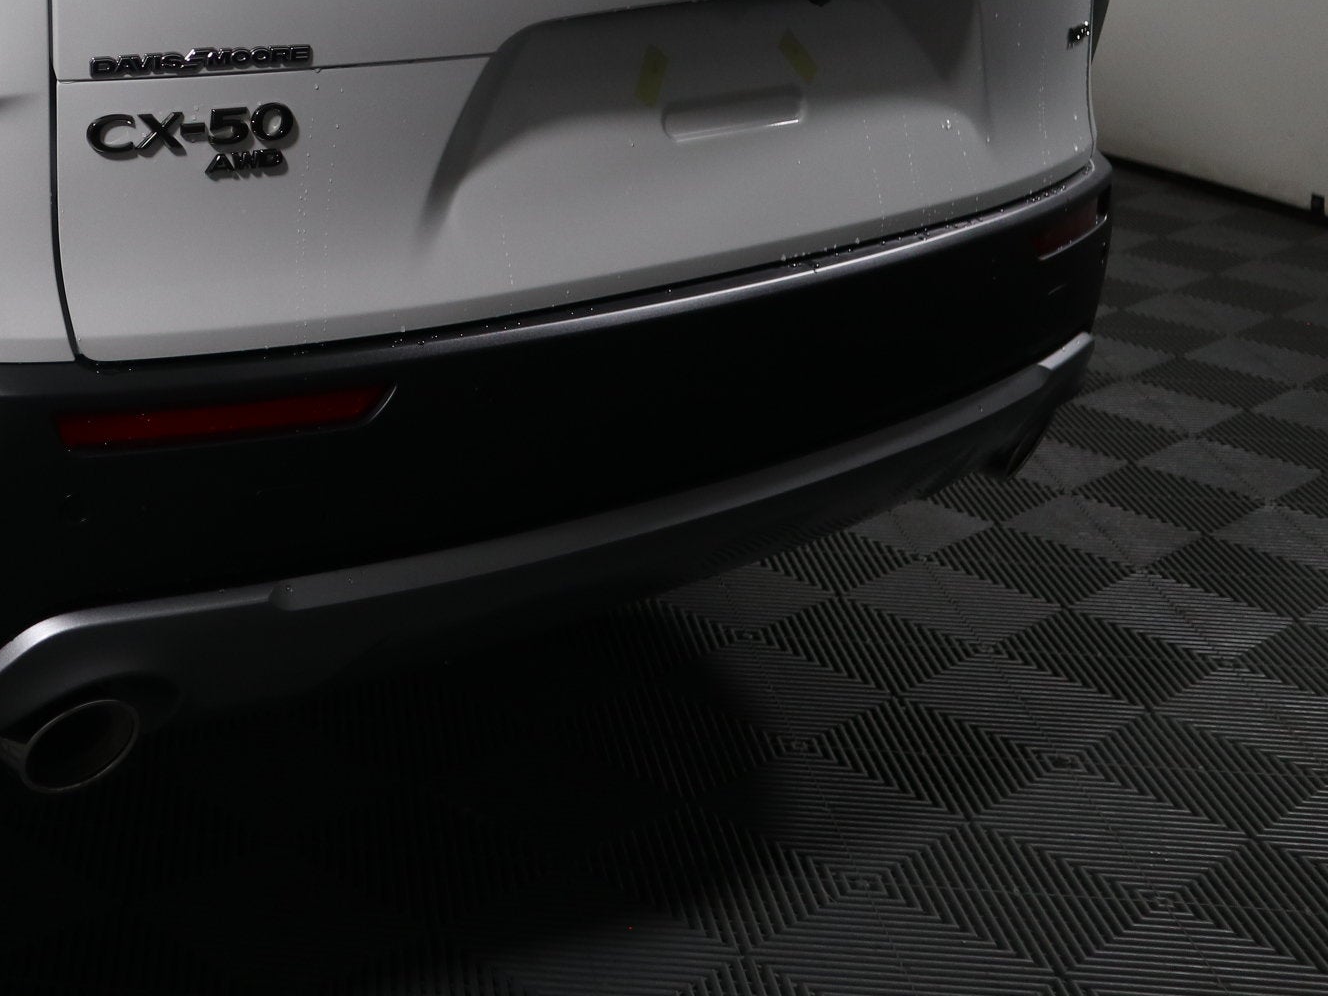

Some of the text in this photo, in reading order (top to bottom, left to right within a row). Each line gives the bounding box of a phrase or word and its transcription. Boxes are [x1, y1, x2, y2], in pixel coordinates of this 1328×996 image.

[89, 44, 314, 79] DAVIS MOORE
[85, 102, 295, 156] CX-50
[204, 148, 285, 178] AWD
